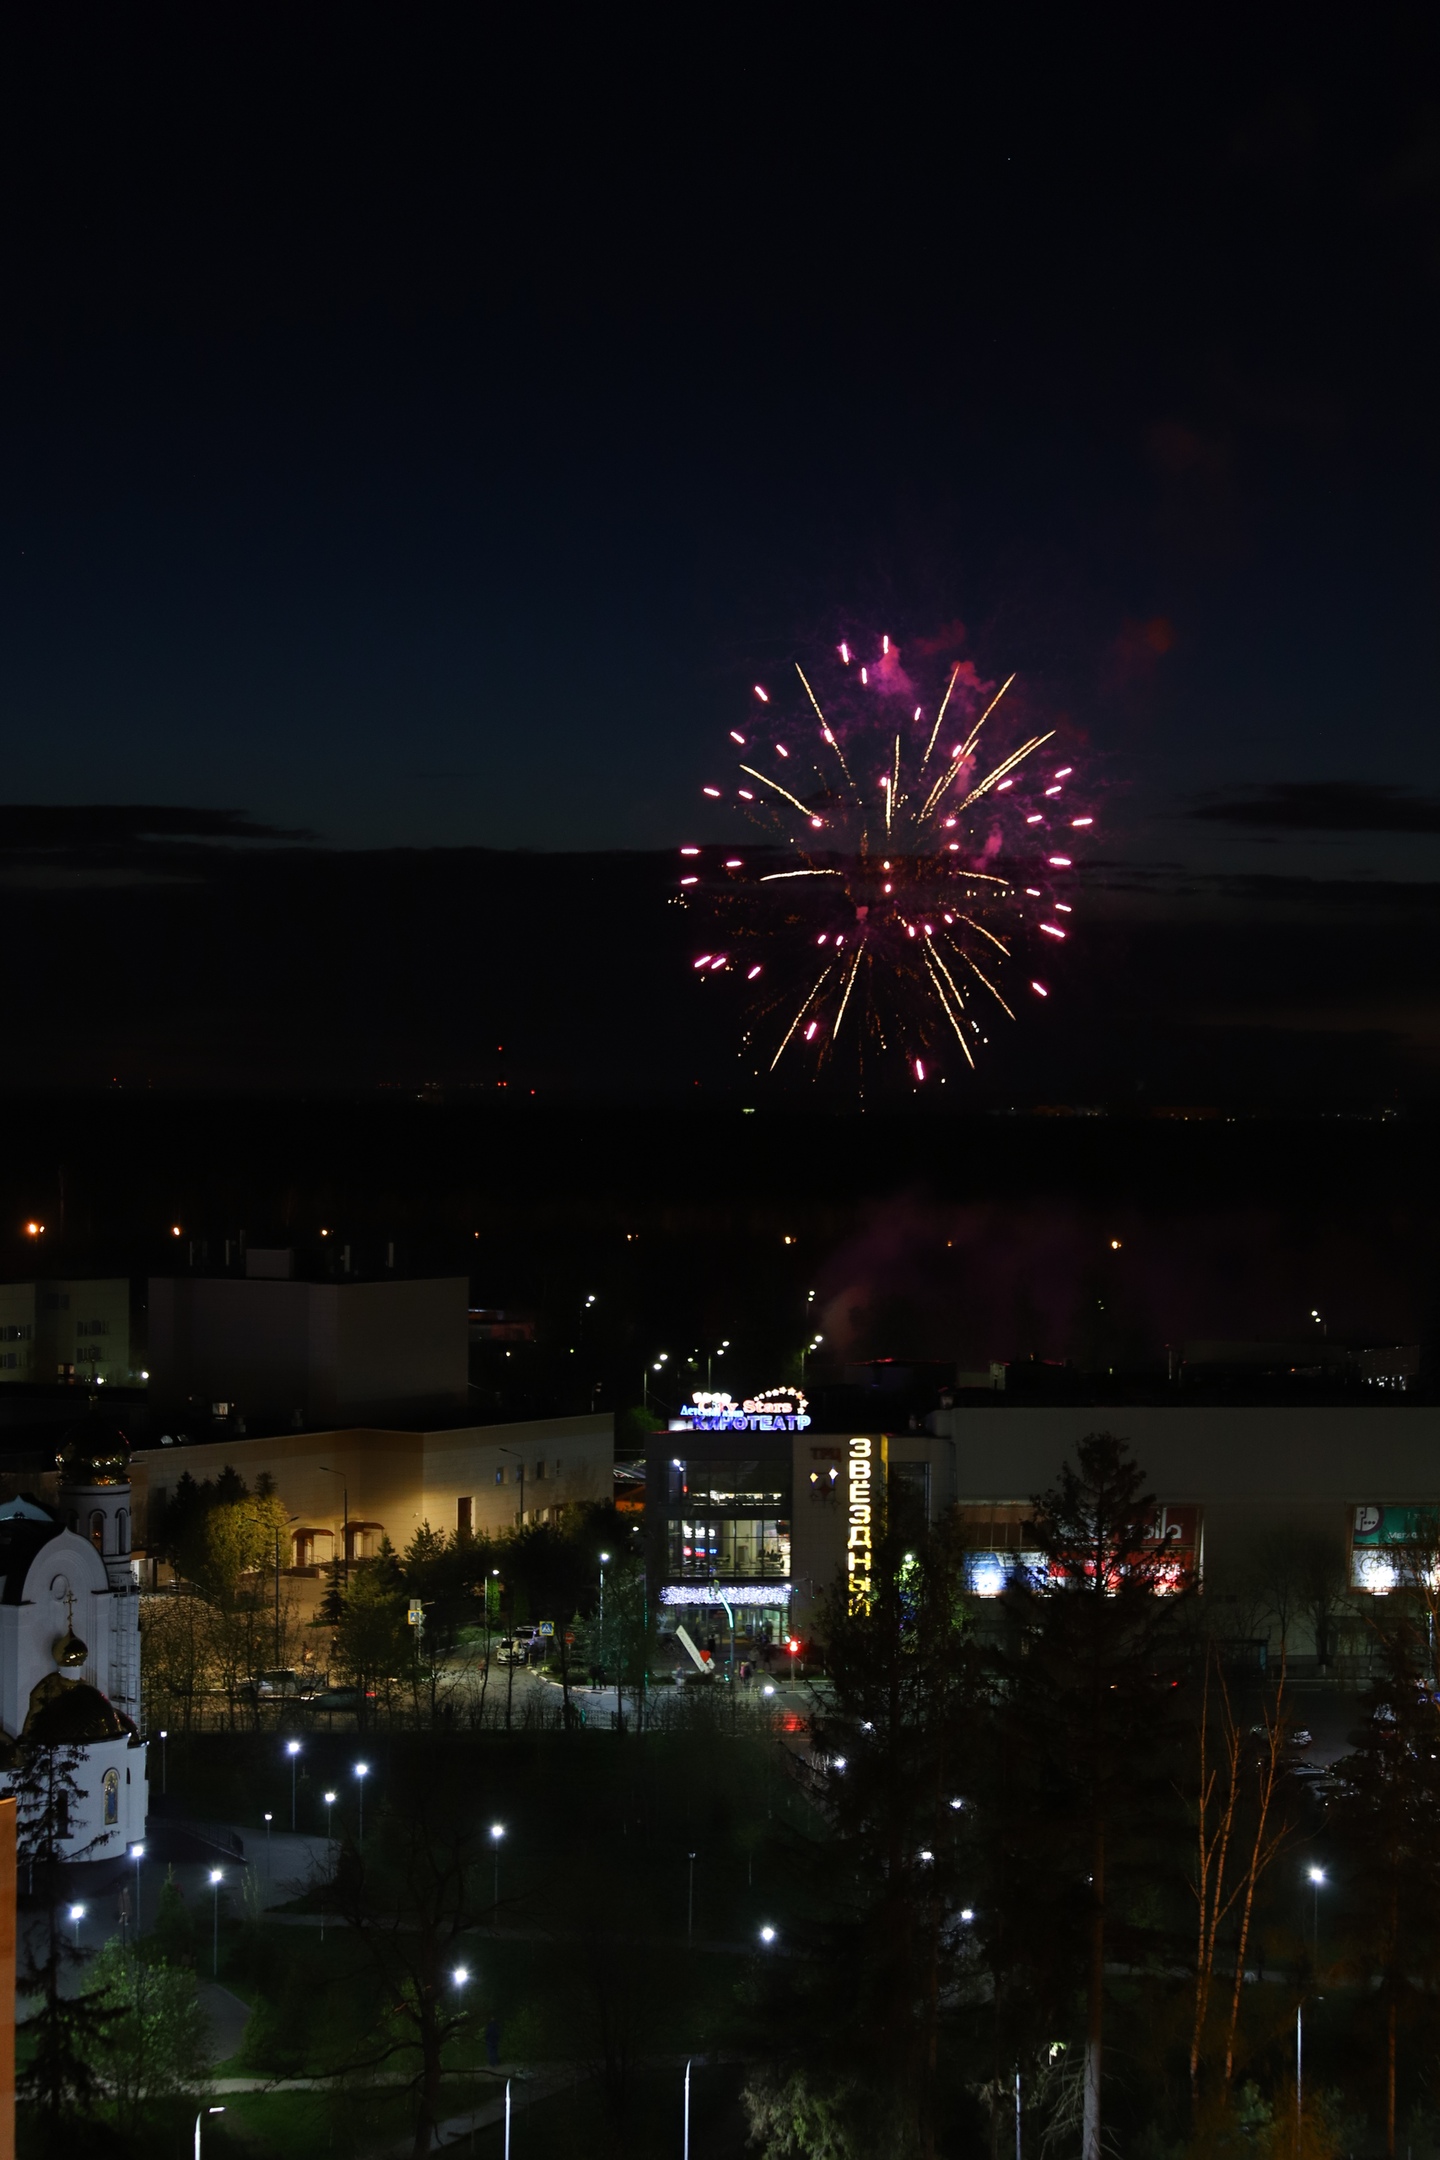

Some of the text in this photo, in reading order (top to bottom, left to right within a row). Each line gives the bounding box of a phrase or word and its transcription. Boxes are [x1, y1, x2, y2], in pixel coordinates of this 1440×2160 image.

[743, 1400, 792, 1413] Stars
[693, 1415, 811, 1431] КИНОТЕАТР
[810, 1447, 842, 1463] ТРЦ
[847, 1437, 872, 1616] ЗВЁЗДНЫЙ
